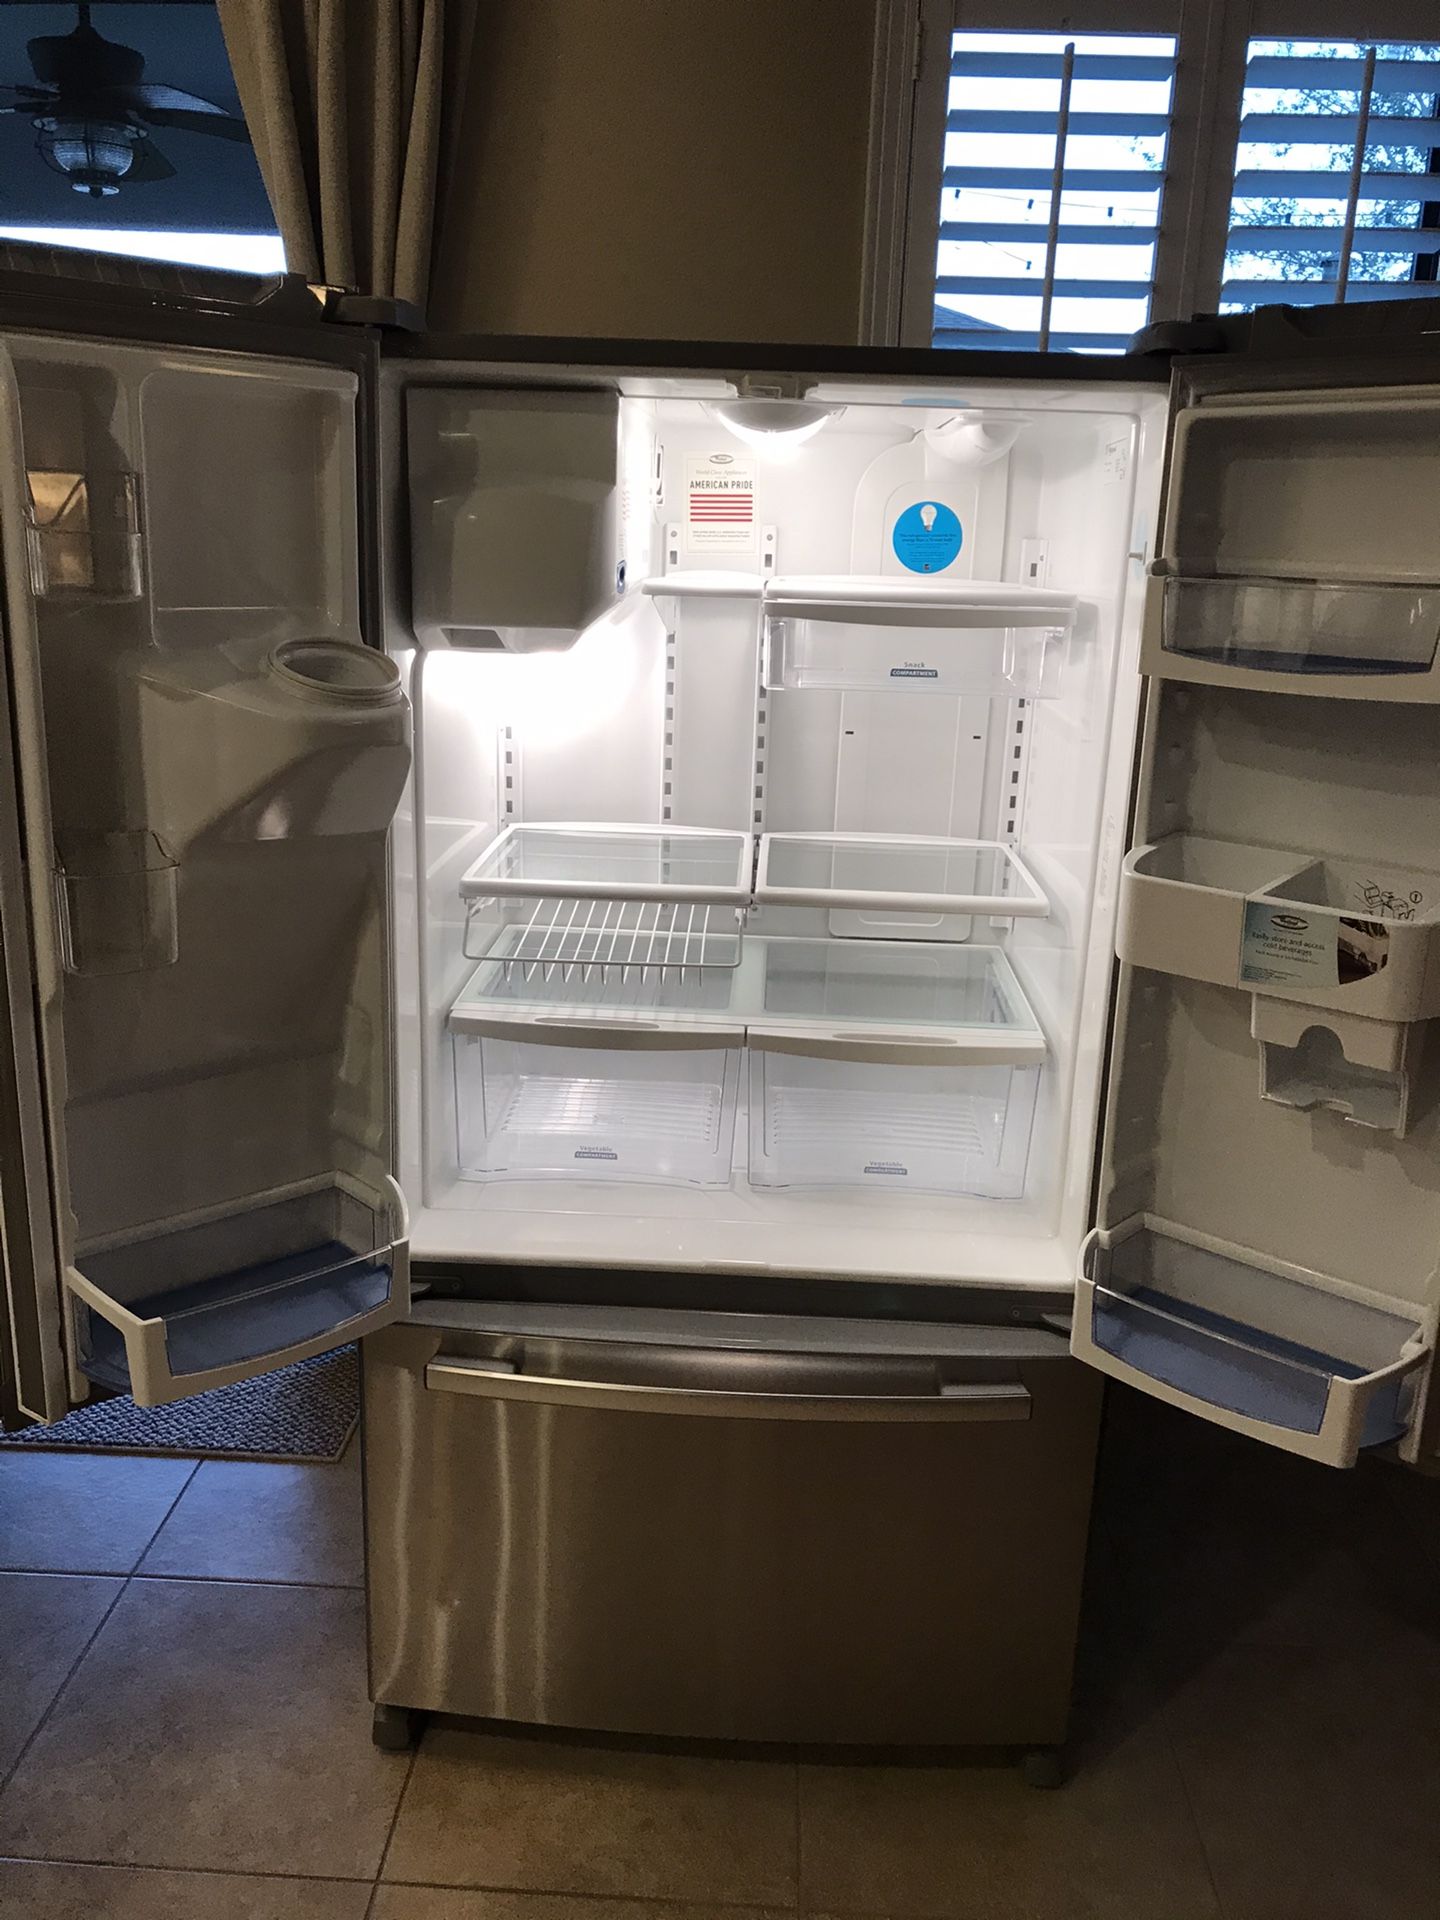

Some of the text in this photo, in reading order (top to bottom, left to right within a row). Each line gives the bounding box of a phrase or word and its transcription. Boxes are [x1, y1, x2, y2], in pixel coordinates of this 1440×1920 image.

[690, 480, 753, 489] AMERICAN PRIDE
[892, 669, 936, 677] COMPARTMENT
[1289, 938, 1303, 946] and
[1303, 942, 1325, 950] access
[1278, 943, 1312, 956] beverages
